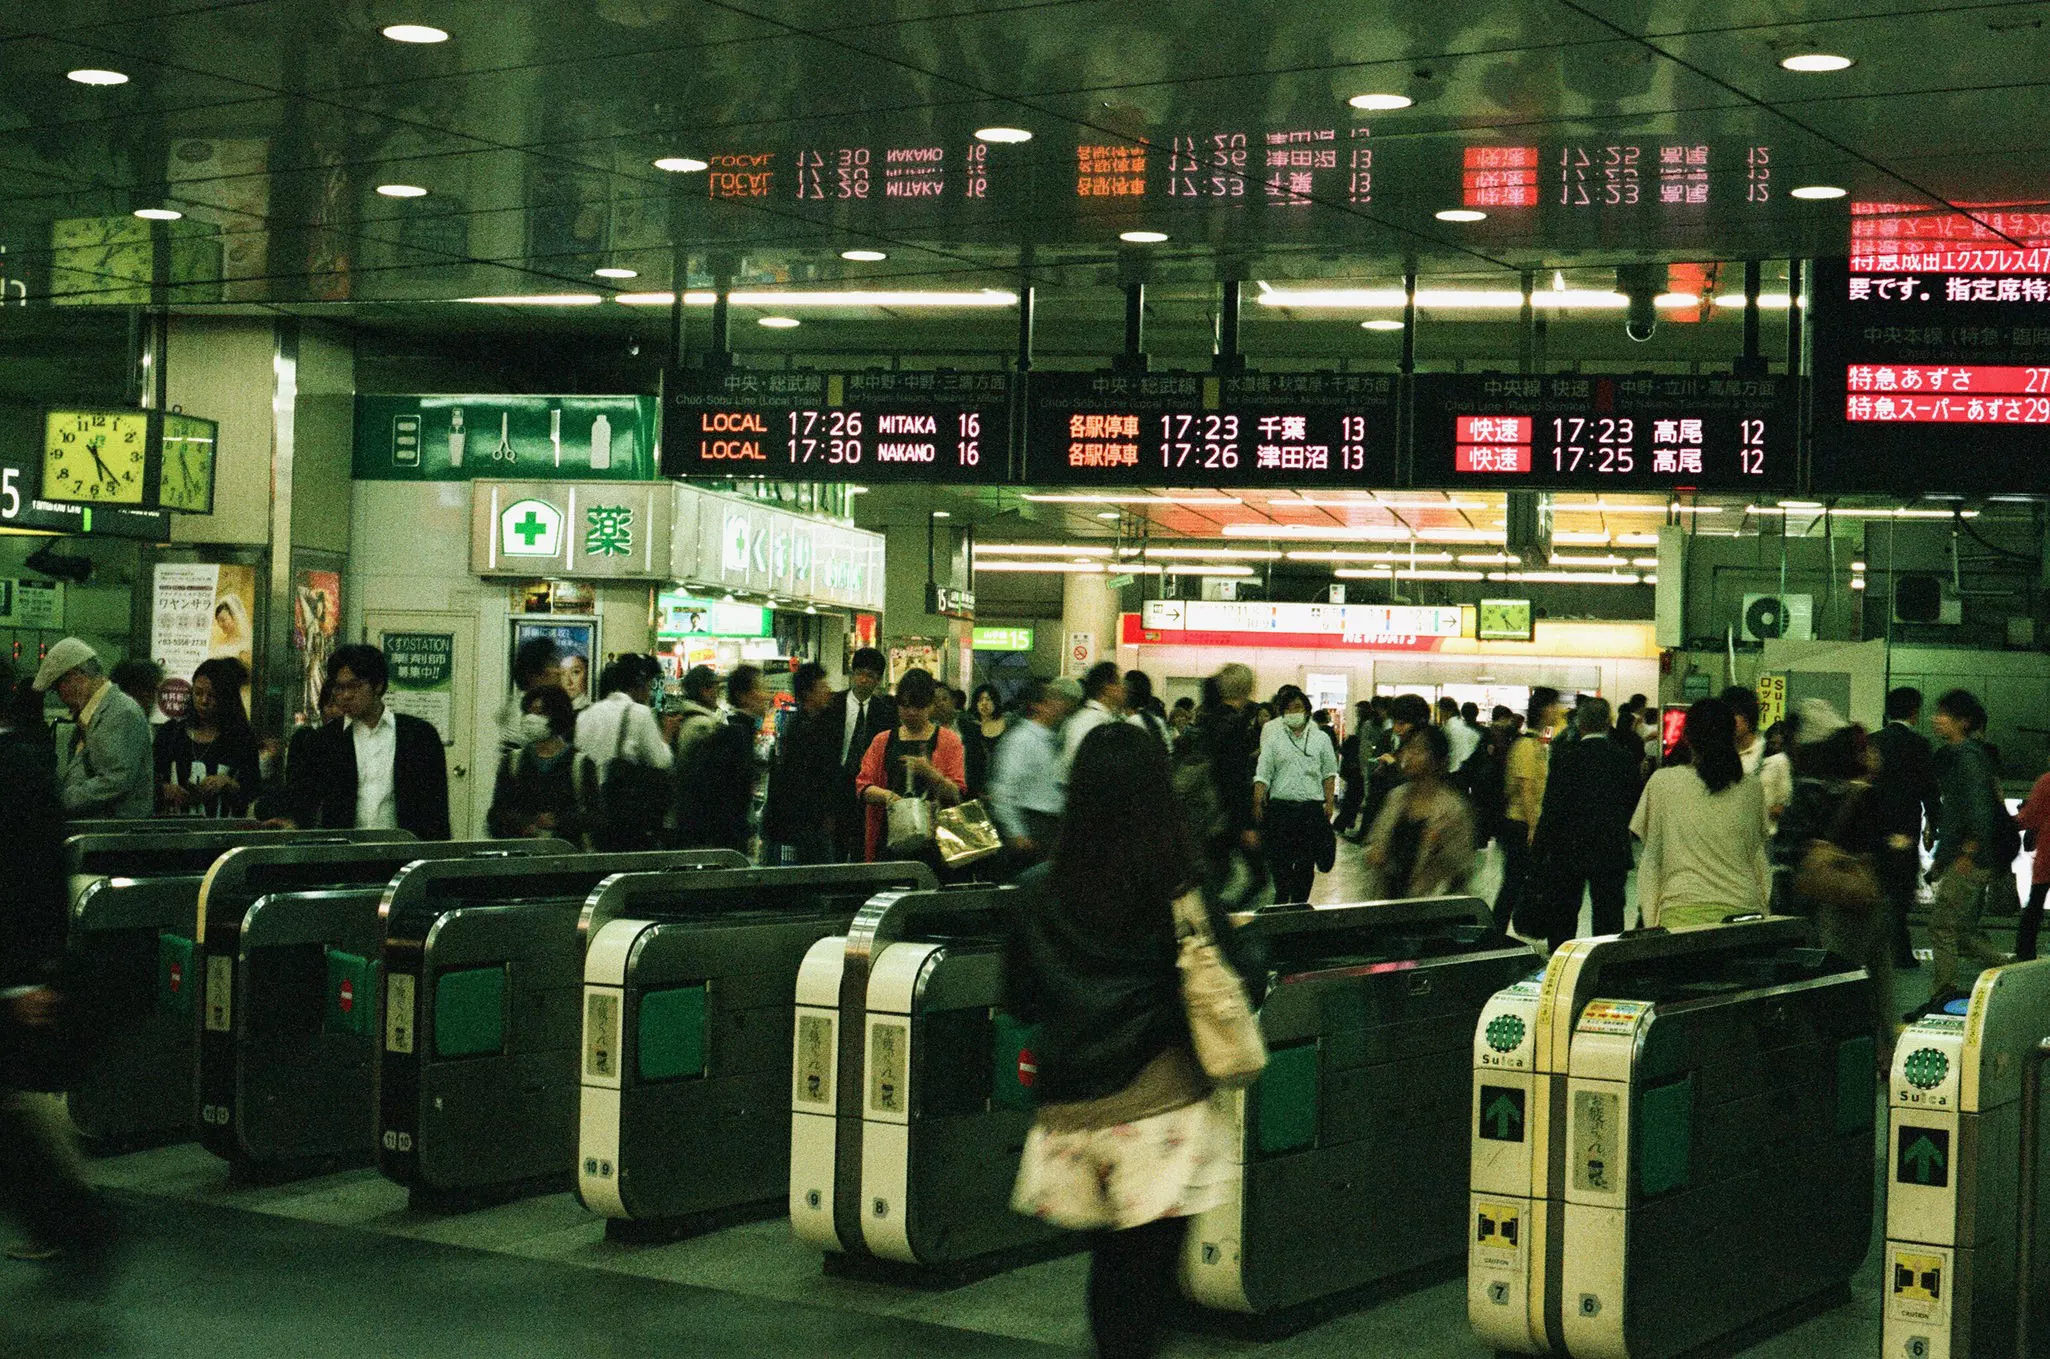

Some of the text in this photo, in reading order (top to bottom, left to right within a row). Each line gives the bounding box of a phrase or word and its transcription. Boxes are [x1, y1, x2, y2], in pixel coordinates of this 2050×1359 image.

[1850, 276, 2050, 302] 要です。指定席特
[1849, 367, 1971, 391] 特急あずさ
[77, 420, 89, 432] 11
[91, 417, 105, 428] 12
[112, 421, 118, 432] 1
[702, 412, 979, 437] LOCAL 17:26 MITAKA 16
[1070, 415, 1364, 441] 各駅停車 17:23 千葉 13
[62, 432, 75, 443] 10
[124, 432, 134, 443] 2
[1470, 418, 1764, 444] 快速 17:23 高尾 12
[54, 448, 63, 459] 9
[130, 452, 139, 462] 3
[702, 439, 979, 465] LOCAL 17:30 NAKANO 16
[1069, 442, 1363, 469] 各駅停車 17:26 津田沼 13
[1469, 447, 1763, 473] 快速 17:25 高尾 12
[60, 468, 69, 479] 8
[122, 471, 131, 481] 4
[74, 480, 83, 491] 7
[90, 485, 99, 497] 6
[106, 482, 115, 493] 5
[584, 503, 634, 557] 薬
[1760, 678, 1771, 723] ロッカー
[1482, 1054, 1524, 1068] Suica
[1899, 1090, 1947, 1105] Suica
[586, 1160, 597, 1173] 10
[875, 1201, 884, 1213] 8
[1495, 1286, 1505, 1300] 7
[1583, 1298, 1594, 1313] 6
[1912, 1341, 1923, 1357] 6
